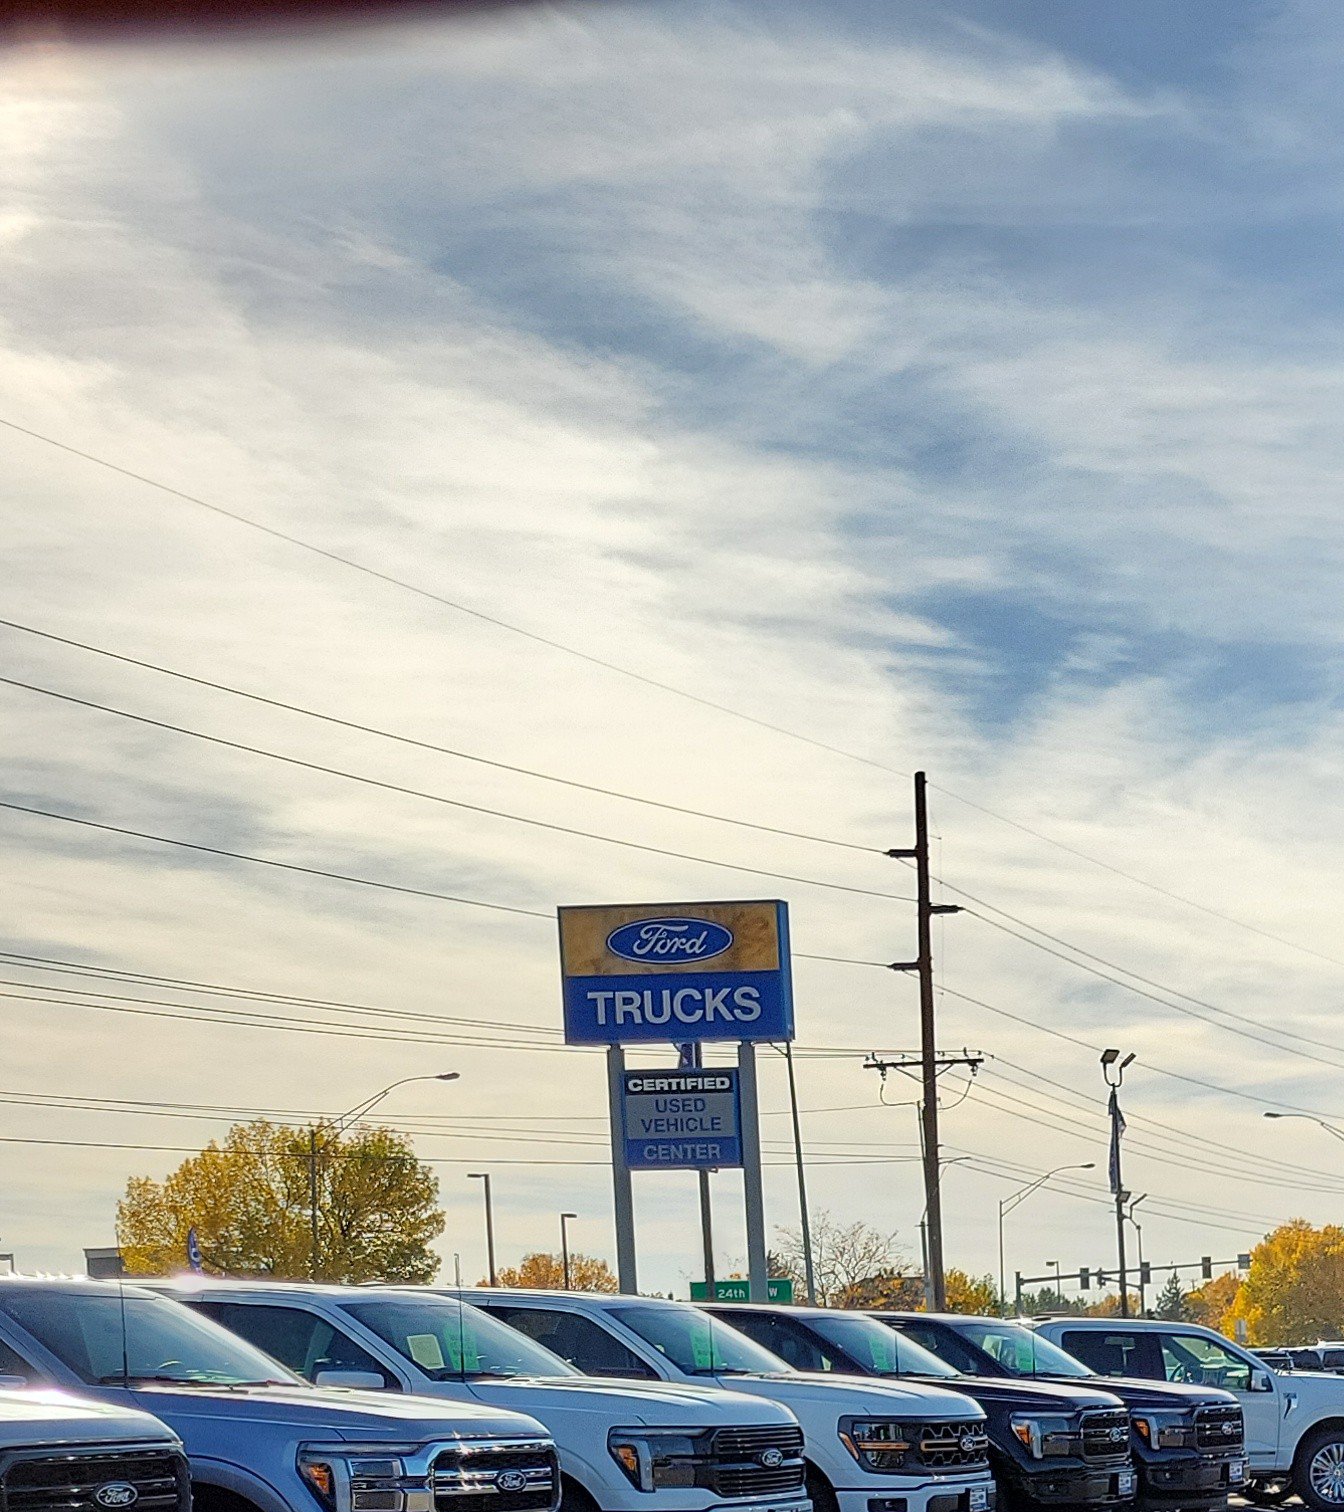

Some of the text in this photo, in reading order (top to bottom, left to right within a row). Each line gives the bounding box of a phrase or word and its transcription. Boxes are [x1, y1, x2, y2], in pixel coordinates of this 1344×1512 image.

[633, 924, 707, 955] Ford
[587, 986, 761, 1024] TRUCKS
[628, 1076, 730, 1092] CERTIFIED
[655, 1099, 706, 1113] USED
[641, 1117, 721, 1133] VEHICLE
[644, 1145, 720, 1160] CENTER
[718, 1287, 777, 1298] 24th W
[105, 1488, 130, 1503] Ford
